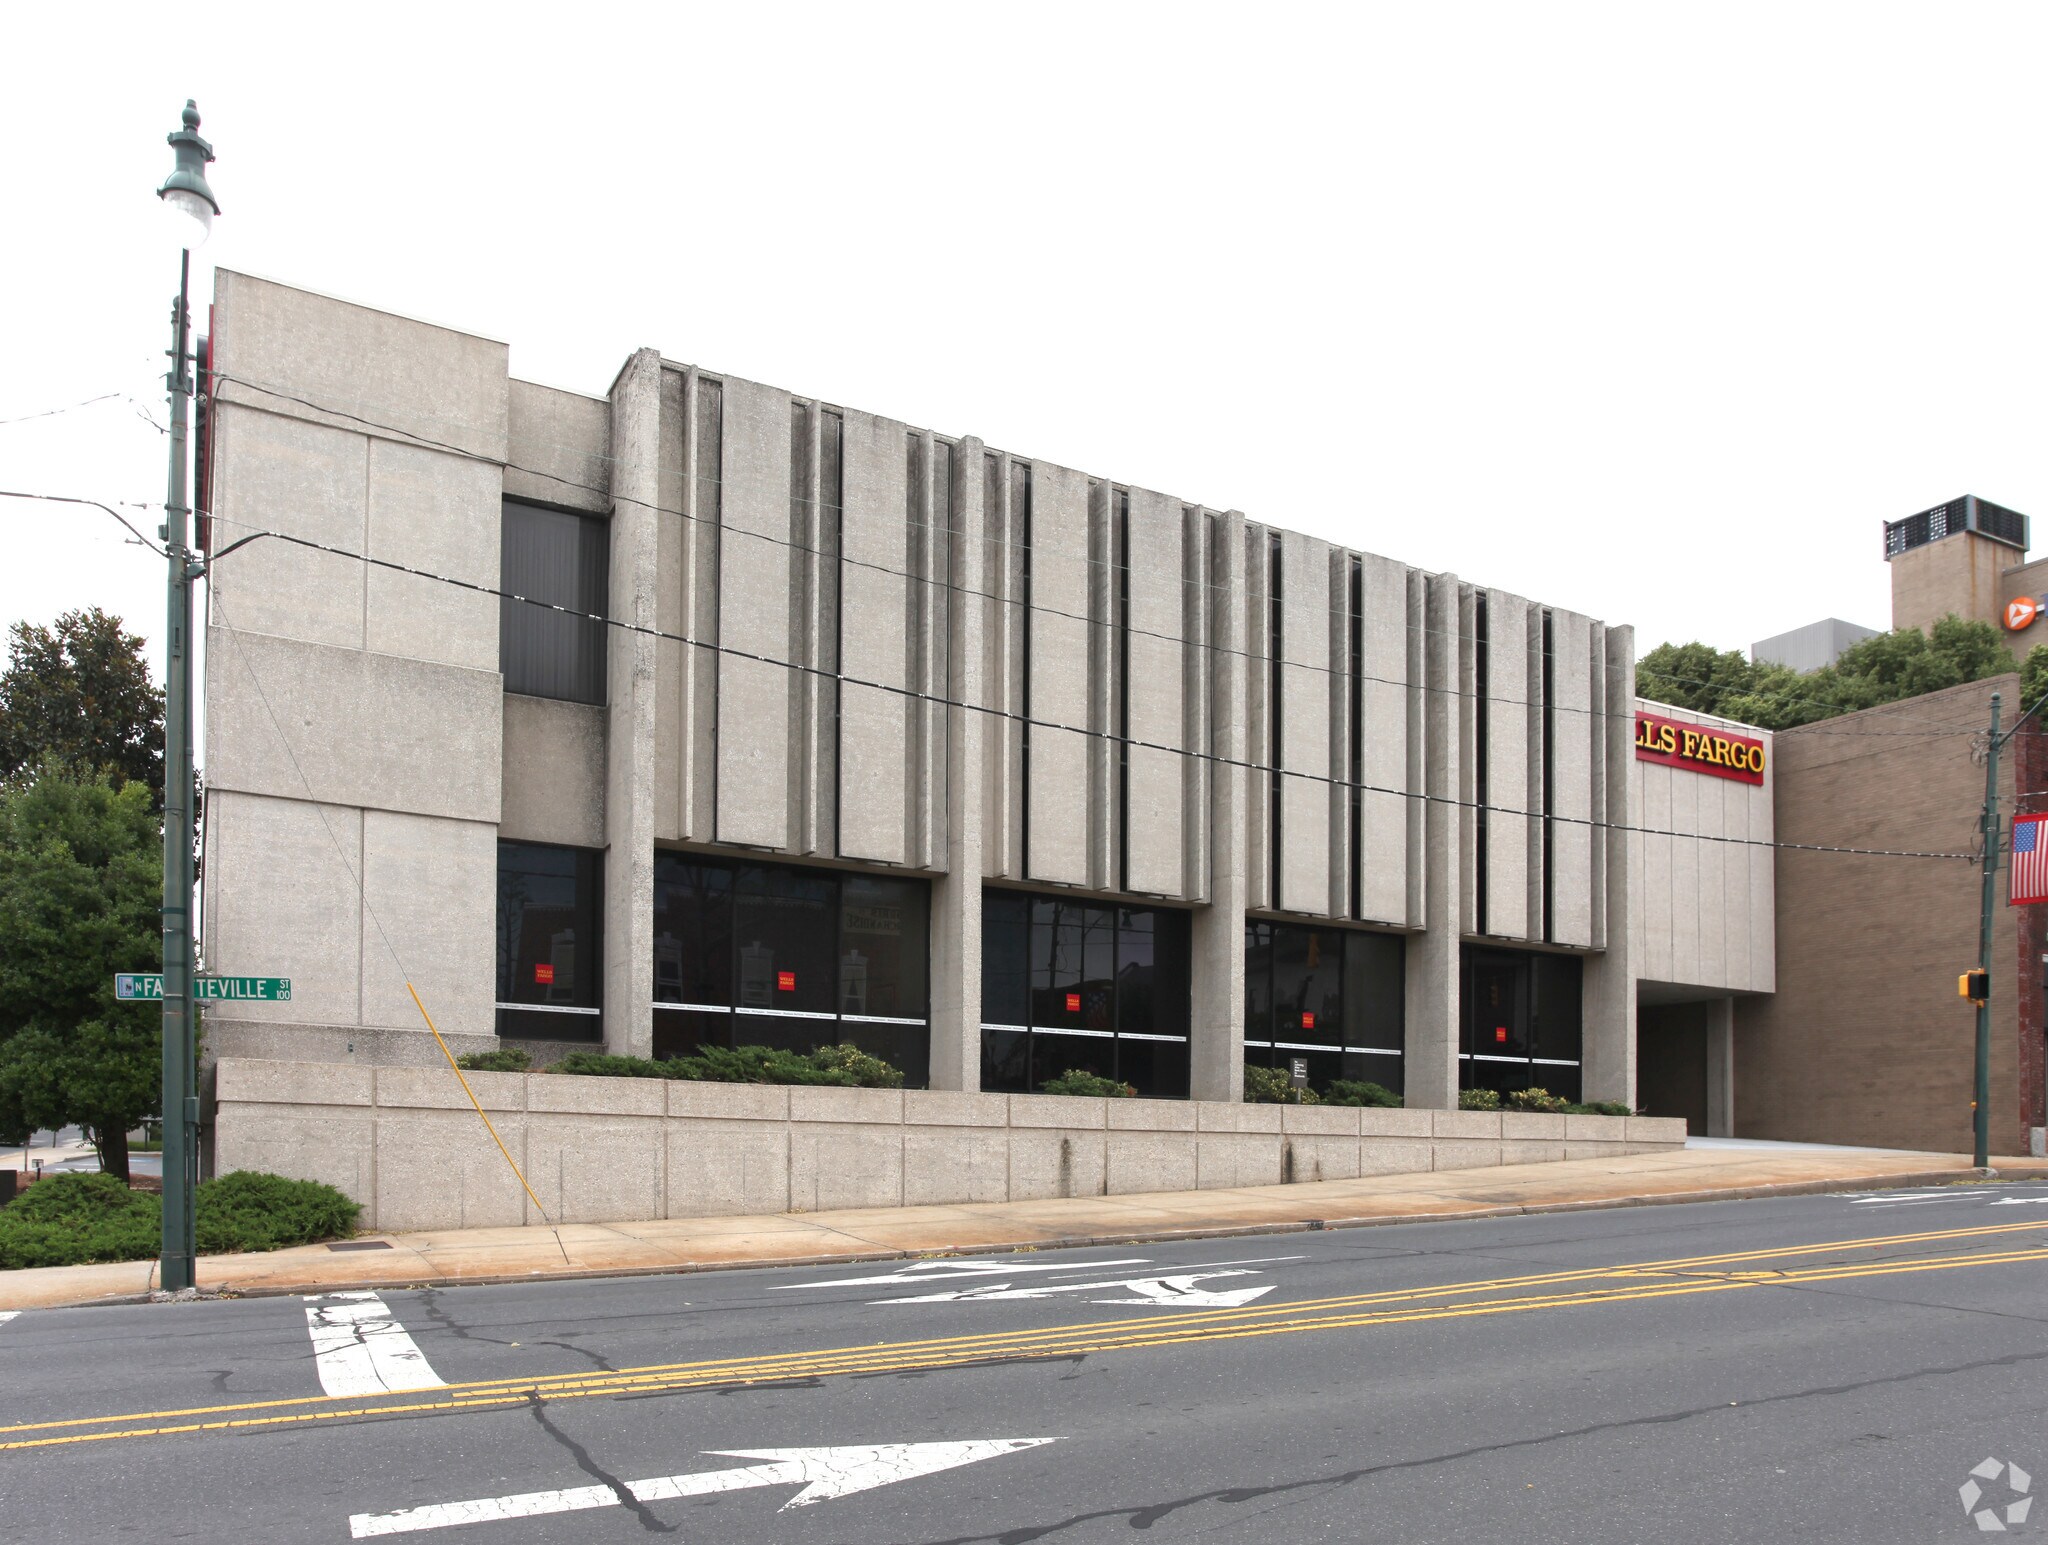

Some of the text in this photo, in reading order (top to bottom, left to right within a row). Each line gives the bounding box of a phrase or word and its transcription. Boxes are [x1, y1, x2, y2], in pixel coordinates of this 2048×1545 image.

[1682, 729, 1766, 773] FARGO
[135, 978, 290, 998] N FATEVILLE ST
[276, 990, 290, 1000] 100
